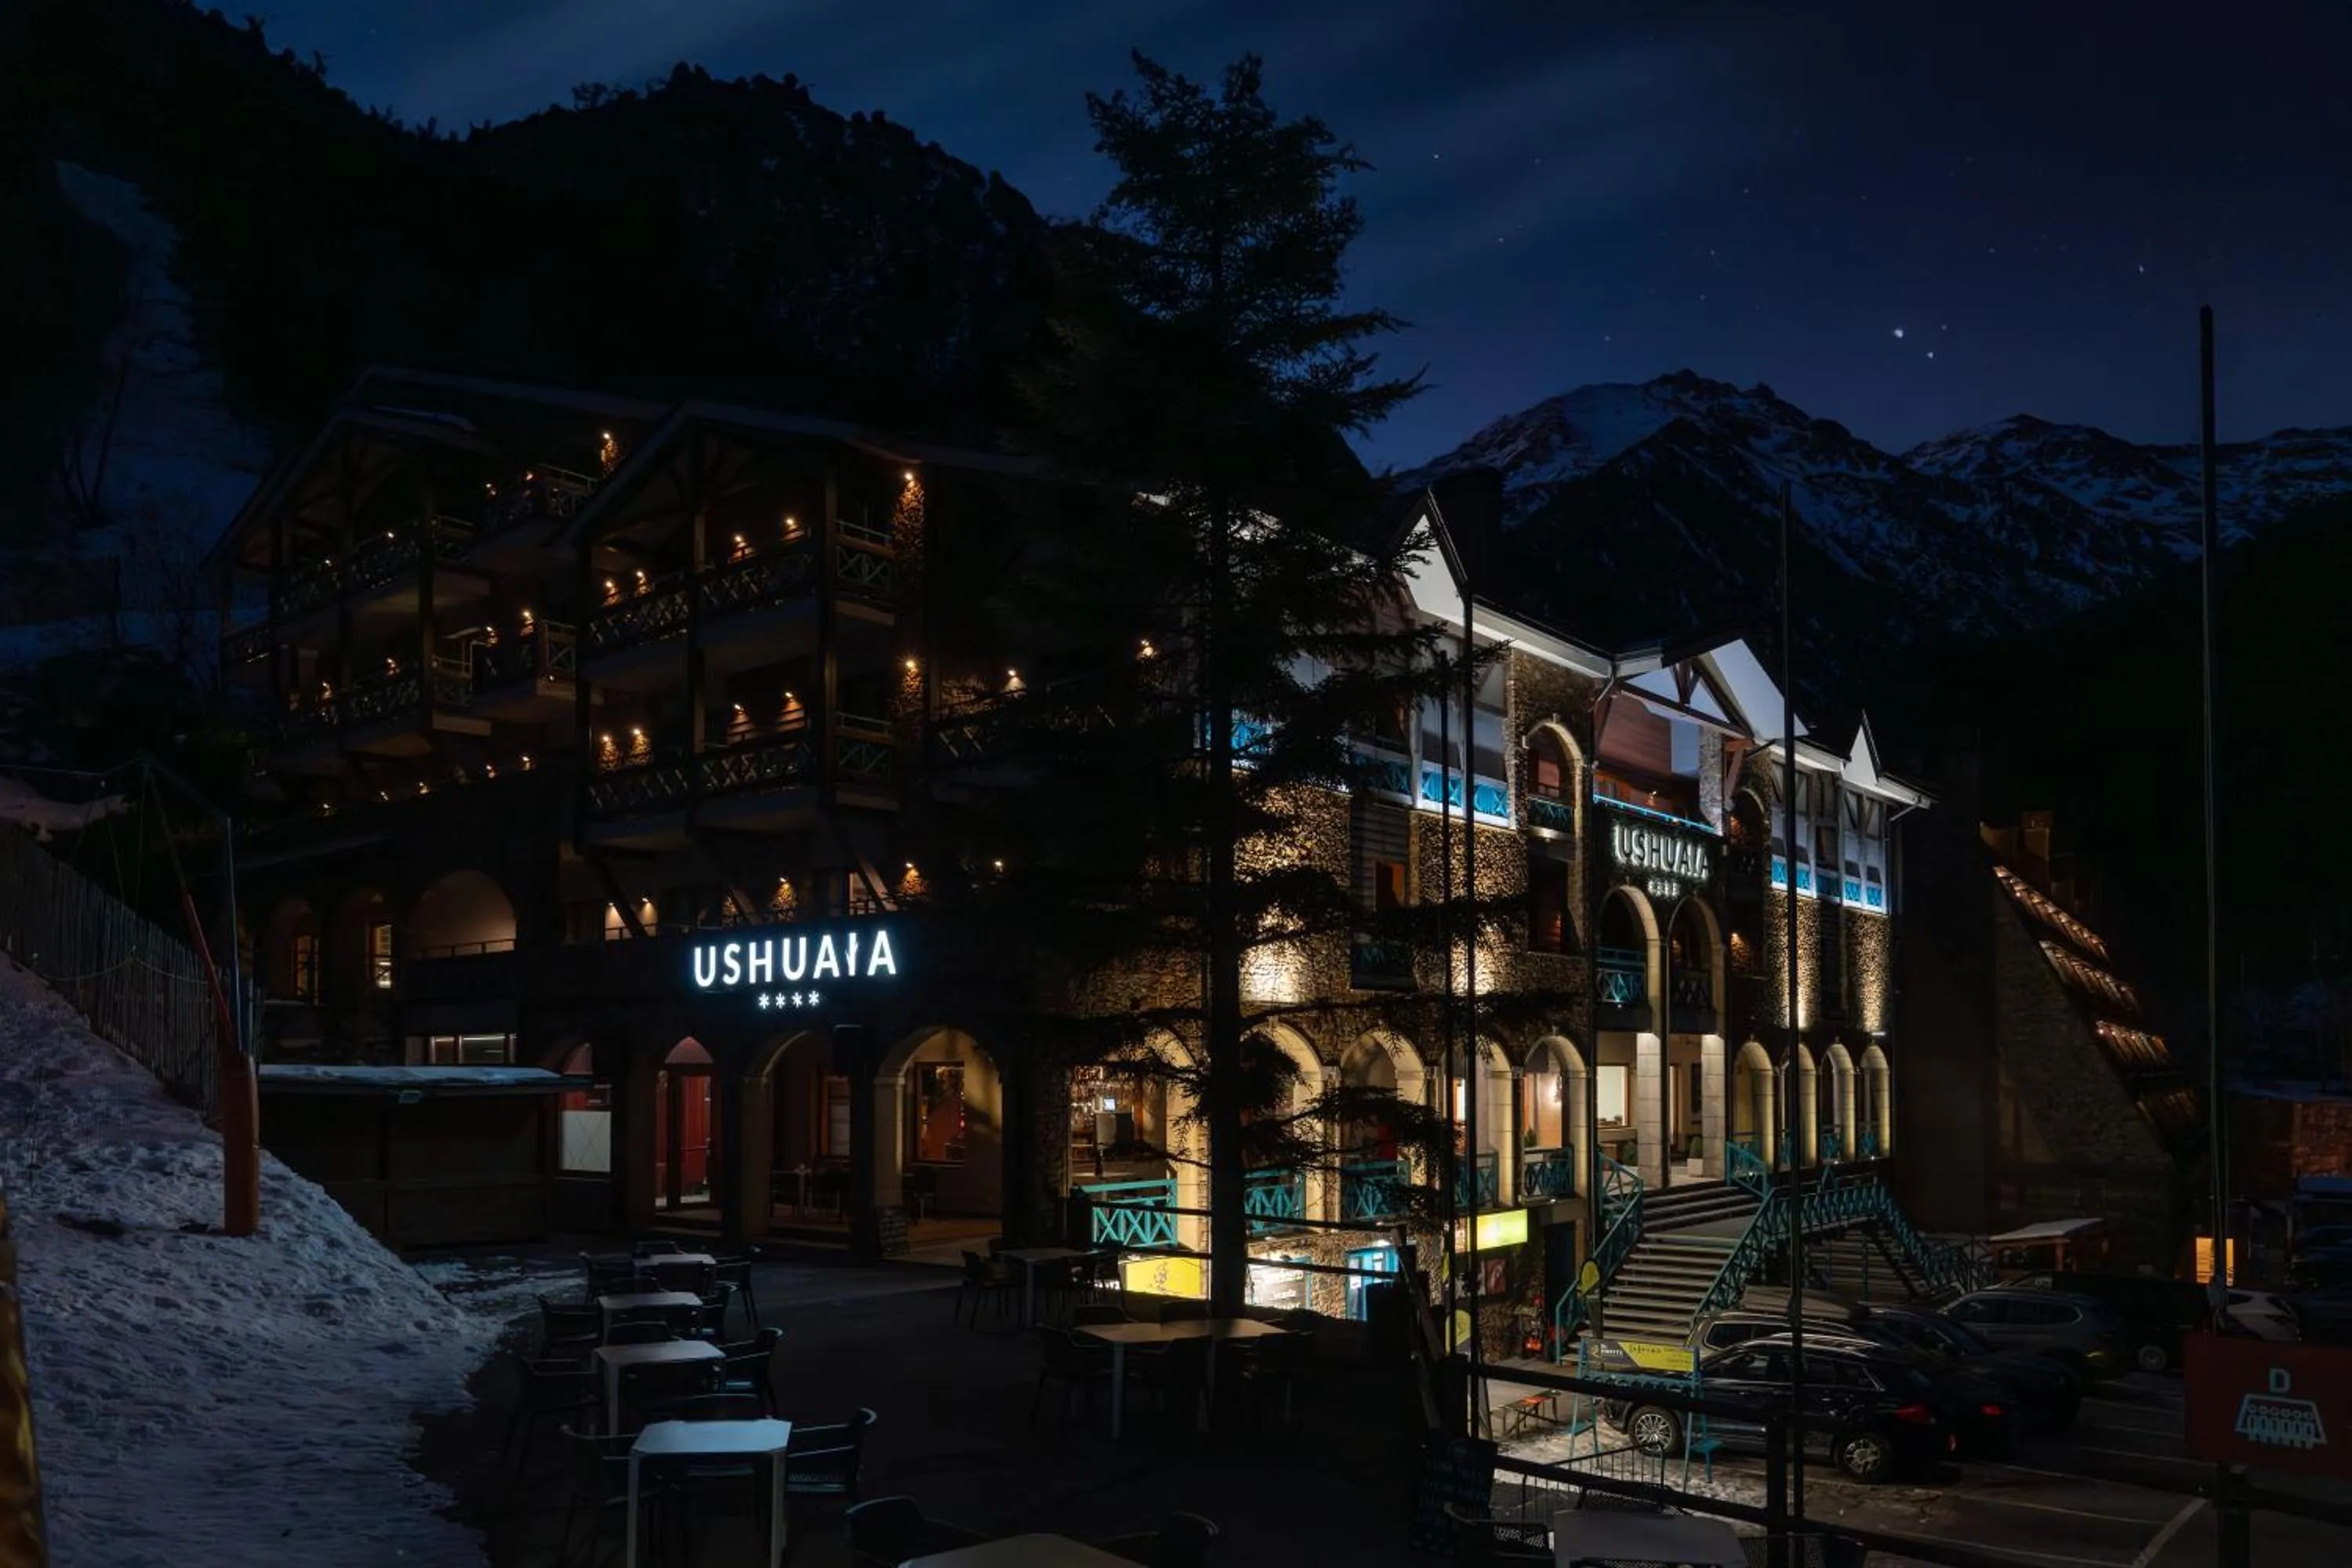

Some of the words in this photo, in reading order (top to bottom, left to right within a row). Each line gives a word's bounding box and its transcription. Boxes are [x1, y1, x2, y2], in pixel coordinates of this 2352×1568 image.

[1613, 824, 1710, 880] USHUAIA
[694, 930, 897, 987] USHUAIA
[2268, 1367, 2291, 1393] D
